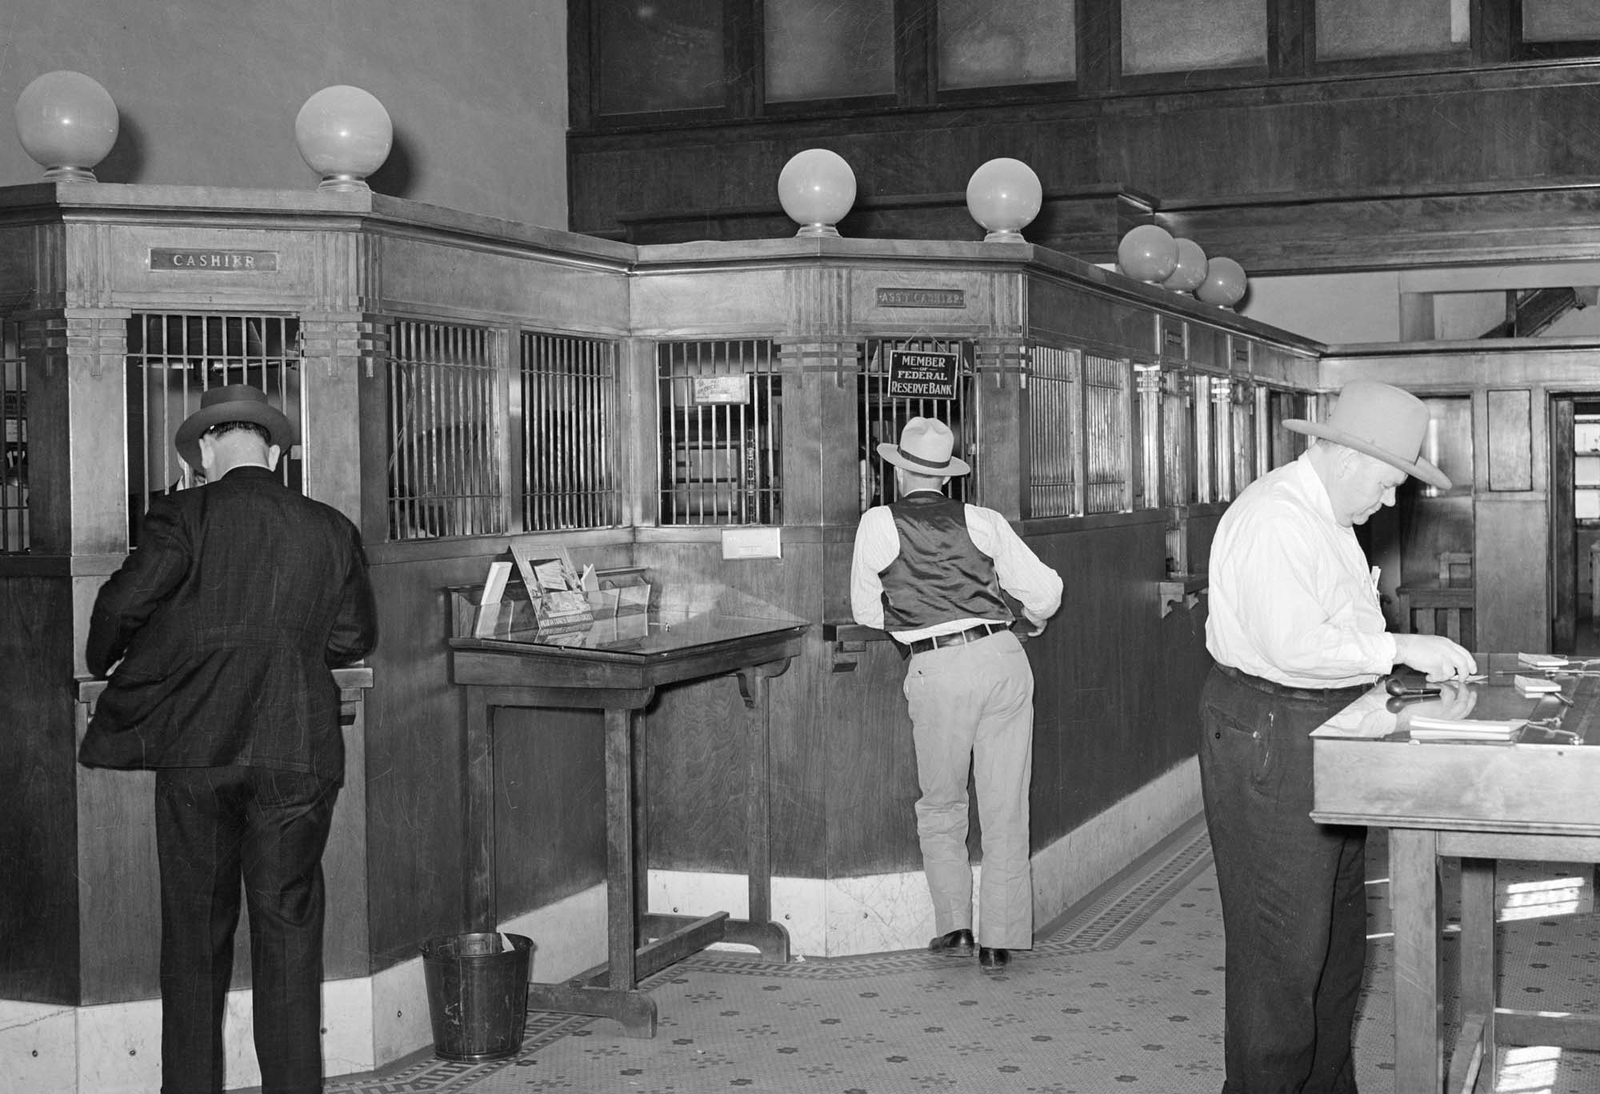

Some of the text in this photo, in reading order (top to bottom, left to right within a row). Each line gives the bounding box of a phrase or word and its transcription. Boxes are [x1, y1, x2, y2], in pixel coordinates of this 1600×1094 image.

[173, 254, 254, 268] CASHIER
[902, 355, 946, 368] MEMBER
[898, 370, 948, 381] FEDERAL
[891, 380, 953, 395] RESERVE BANK
